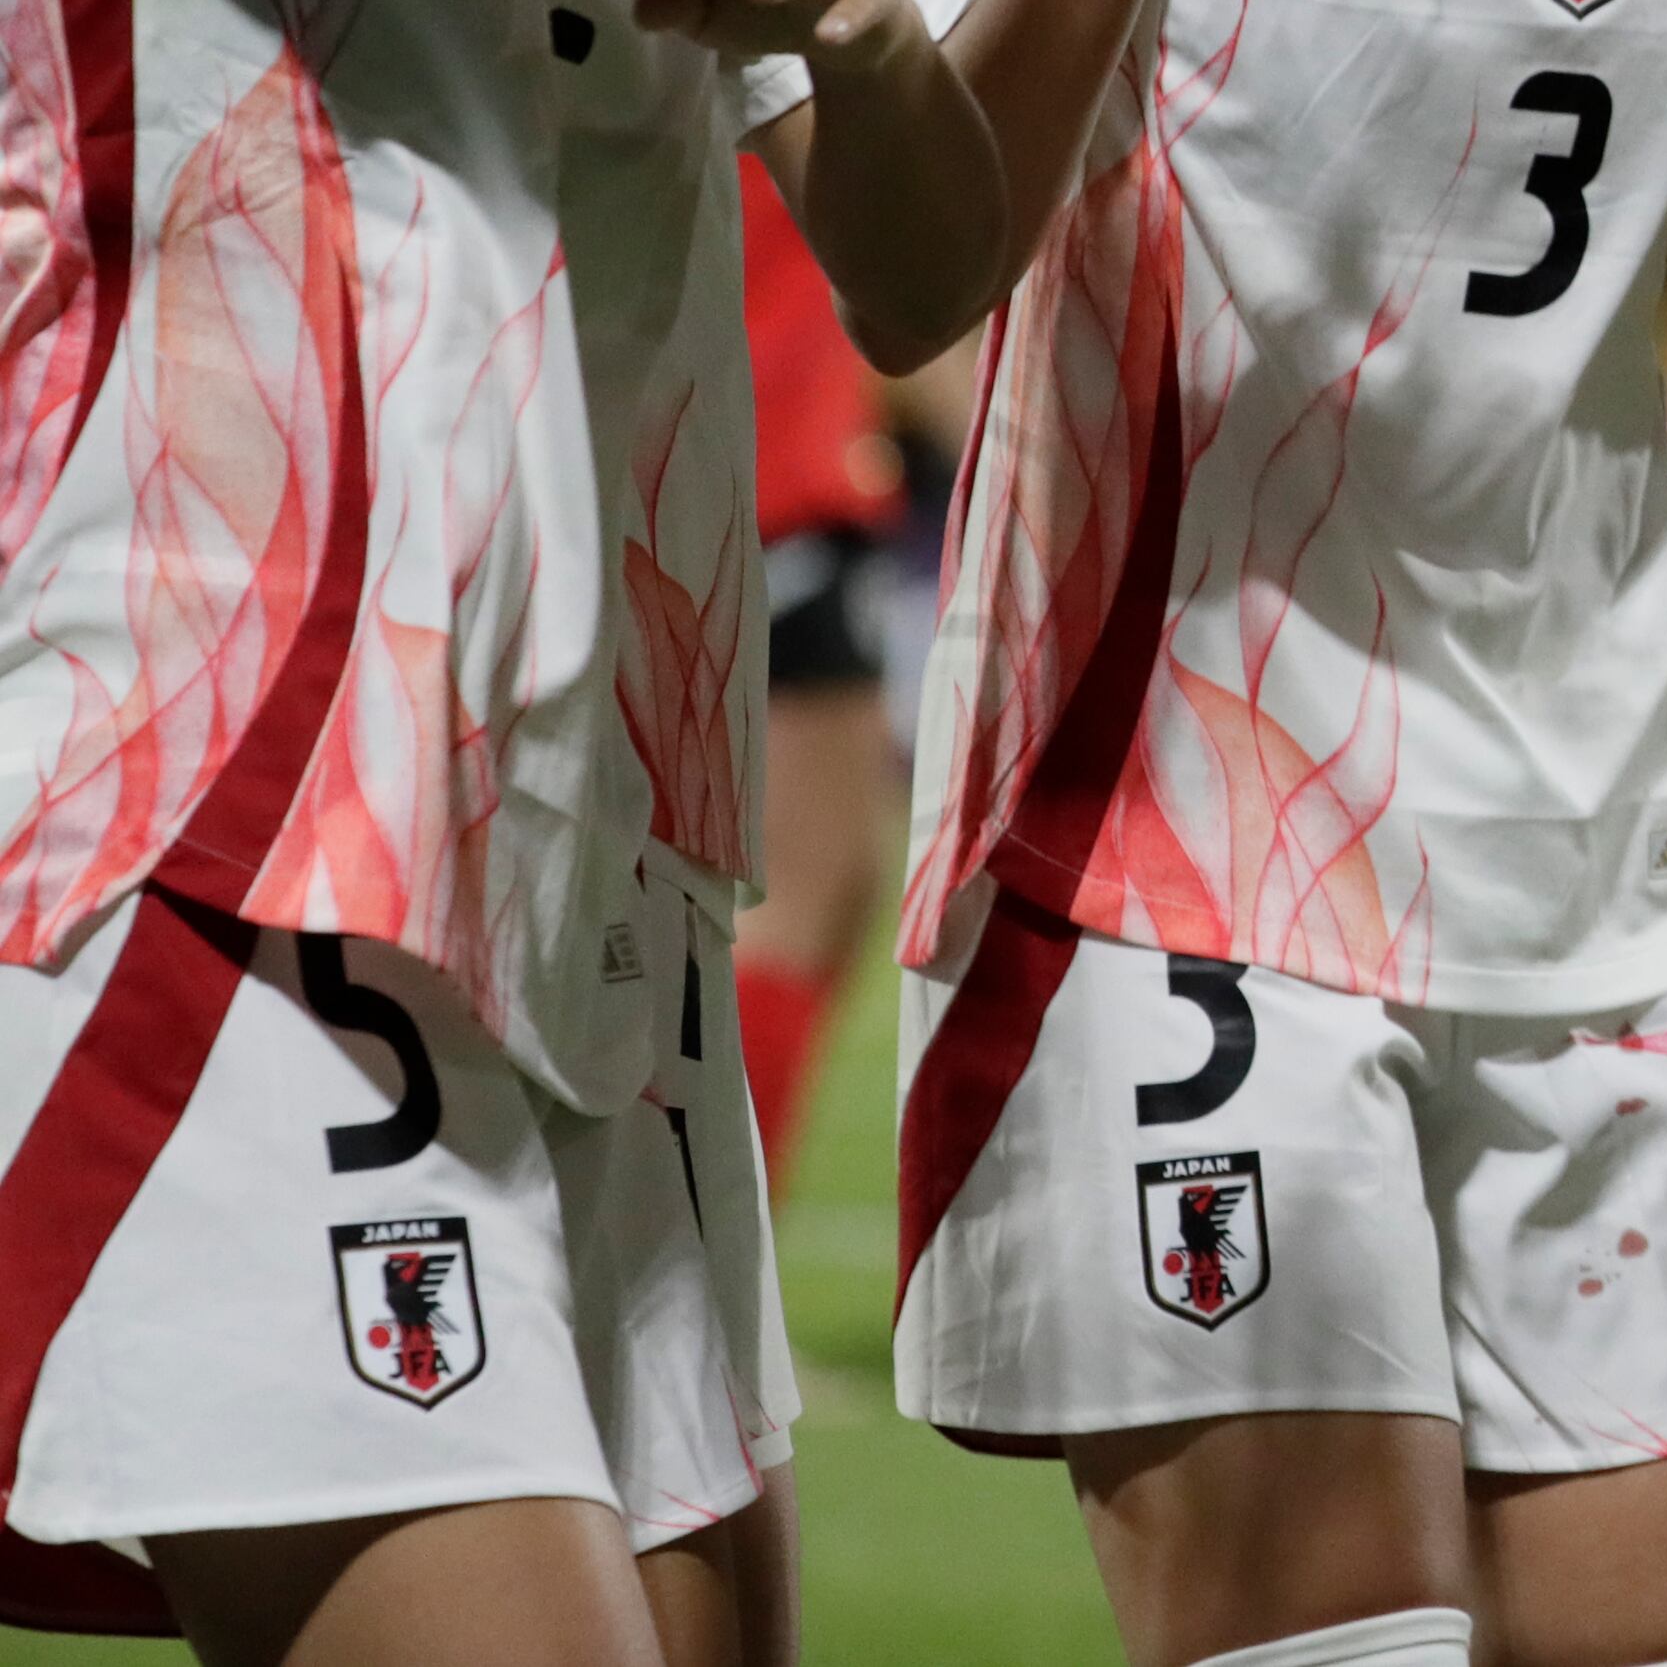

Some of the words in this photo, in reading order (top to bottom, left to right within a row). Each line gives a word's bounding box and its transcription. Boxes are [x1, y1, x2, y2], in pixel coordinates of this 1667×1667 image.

[1463, 70, 1613, 317] 3
[1162, 1156, 1231, 1179] JAPAN
[361, 1221, 440, 1244] JAPAN
[1179, 1273, 1236, 1303] JFA
[388, 1348, 453, 1380] JFA
